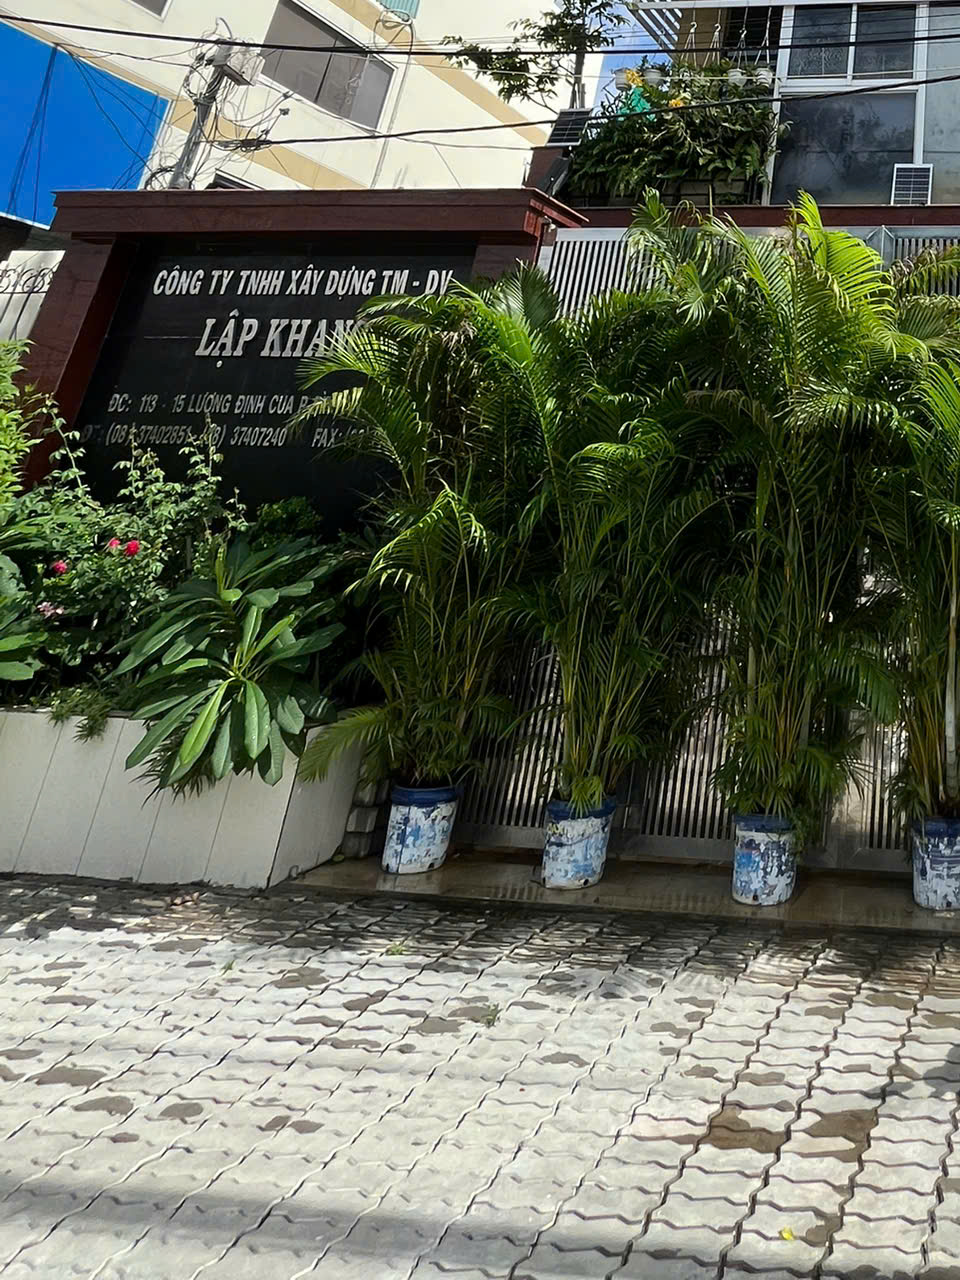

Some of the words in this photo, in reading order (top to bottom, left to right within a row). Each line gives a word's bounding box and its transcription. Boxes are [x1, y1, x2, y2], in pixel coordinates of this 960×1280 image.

[152, 264, 204, 295] CÔNG
[208, 269, 234, 295] TY
[237, 269, 285, 295] TNHH
[285, 263, 325, 295] XÂY
[381, 269, 409, 295] TM
[195, 308, 258, 368] LẬP
[260, 318, 367, 358] KHAN
[139, 394, 159, 413] 113
[230, 426, 287, 447] 37407240
